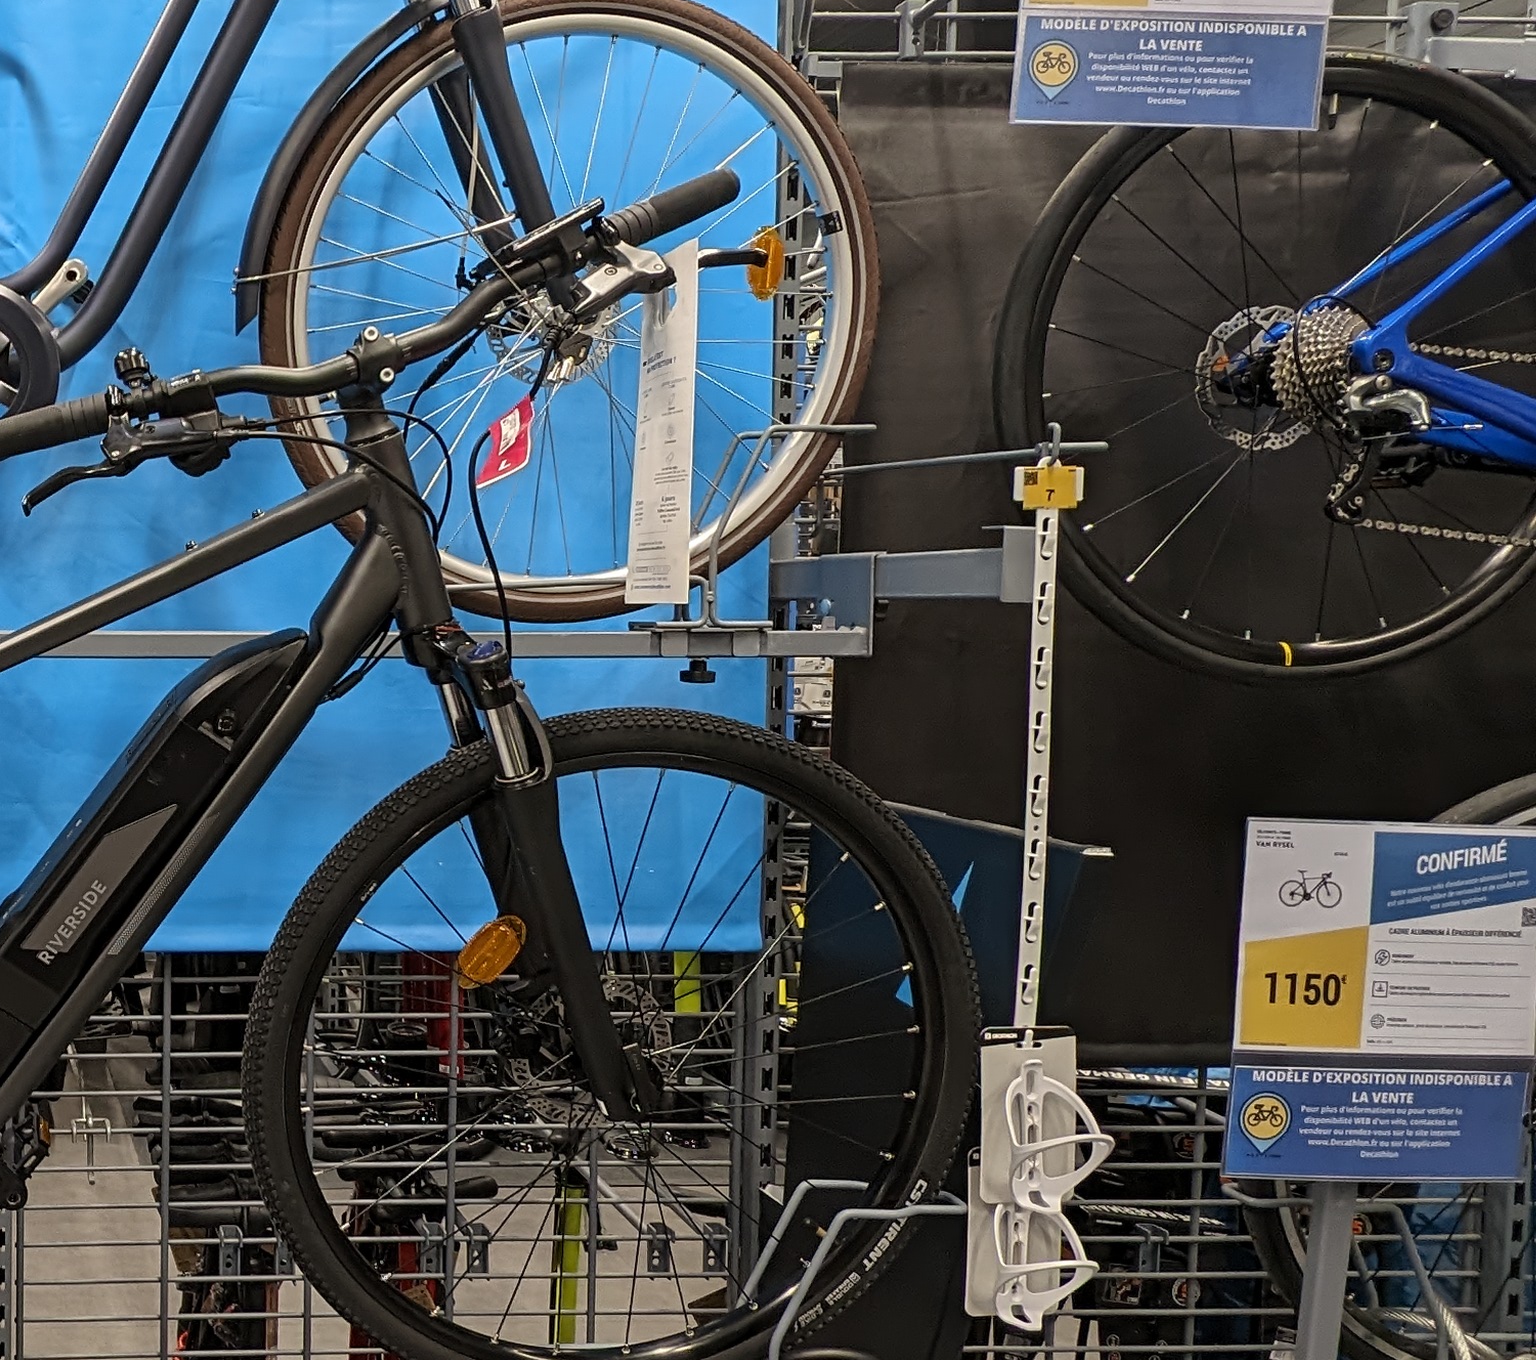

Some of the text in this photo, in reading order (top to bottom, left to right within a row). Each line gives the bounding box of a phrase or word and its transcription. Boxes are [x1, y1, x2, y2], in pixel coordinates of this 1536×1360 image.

[1099, 19, 1196, 33] D'EXPOSITION
[1199, 21, 1294, 37] INDISPONIBLE
[1297, 24, 1307, 36] A
[1139, 38, 1203, 52] LA VENTE
[1088, 52, 1107, 61] Pour
[1126, 51, 1183, 62] d'informations
[1147, 97, 1186, 105] Decathlon
[1046, 489, 1055, 502] 7
[1256, 840, 1271, 848] VAN
[1416, 838, 1508, 875] CONFIRMÉ
[36, 880, 107, 965] RIVERSIDE
[1252, 1068, 1513, 1087] MODÈLE D'EXPOSITION INDISPONIBLE A
[1351, 1091, 1414, 1105] LA VENTE
[1300, 1106, 1319, 1114] Pour
